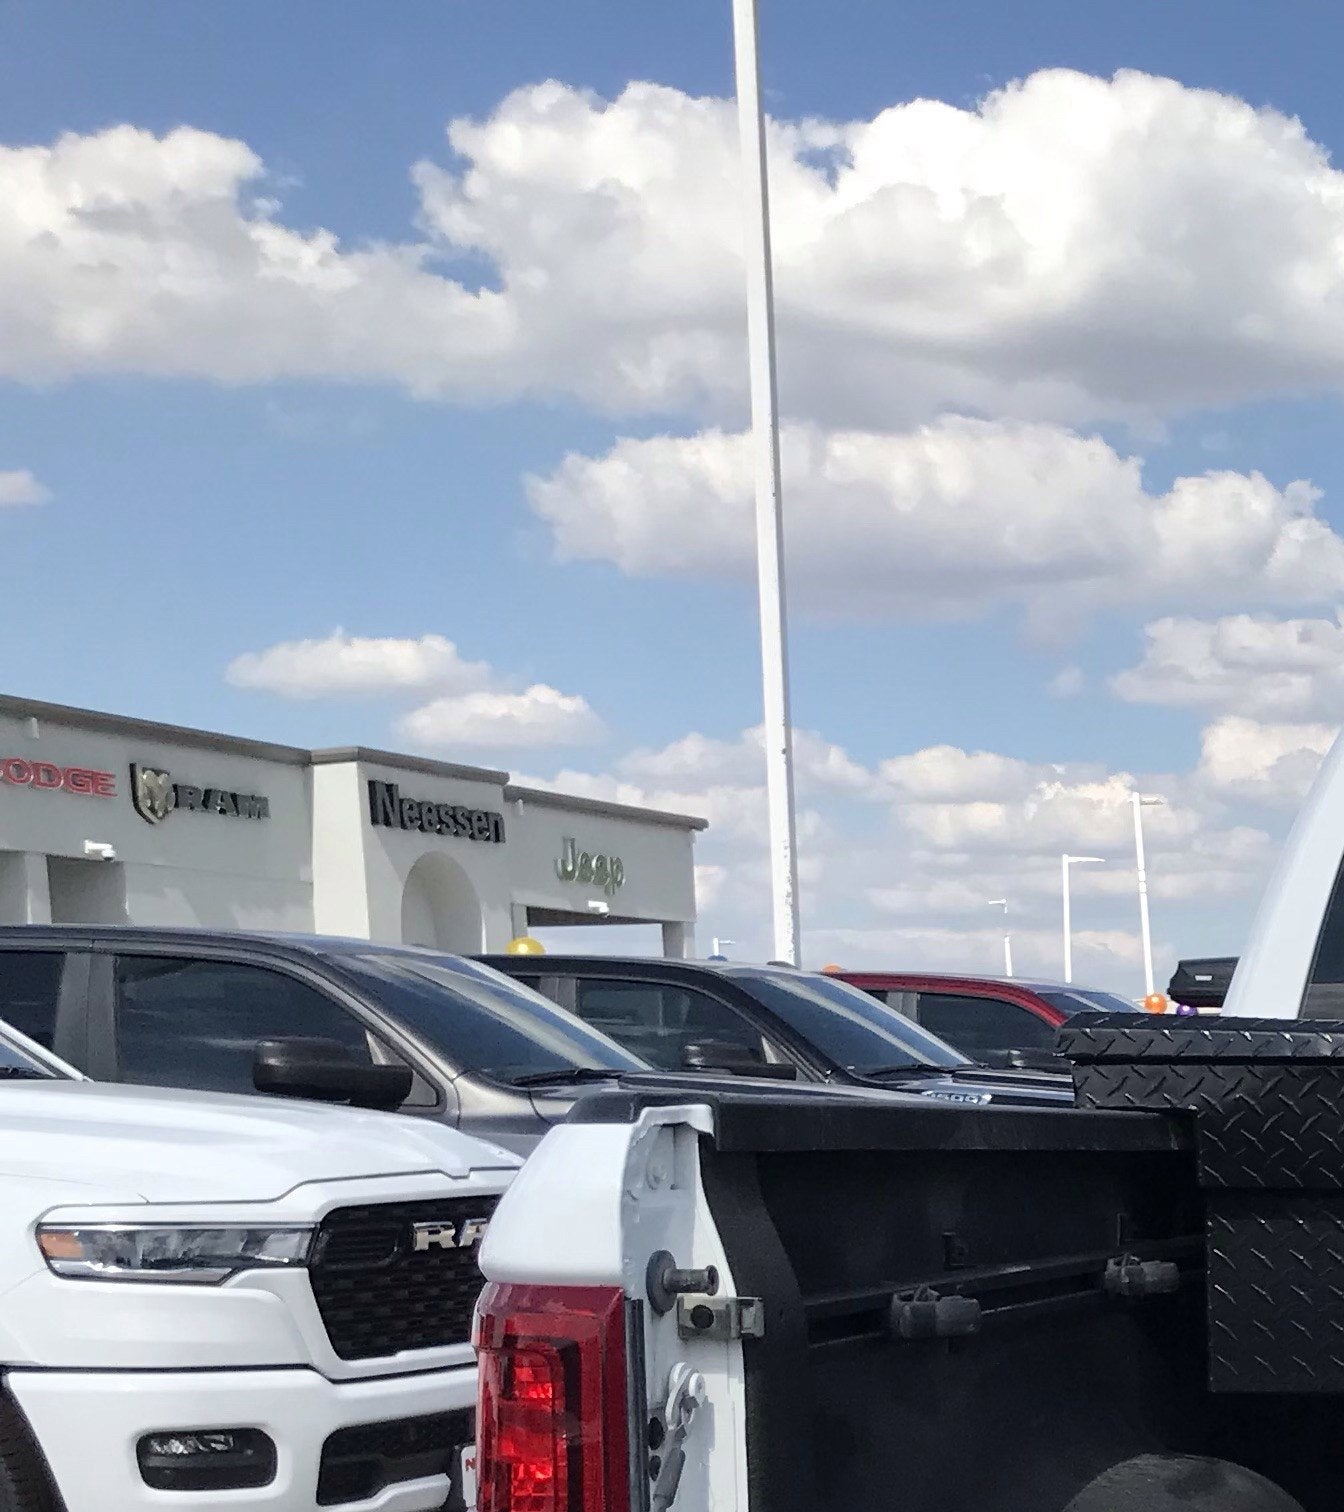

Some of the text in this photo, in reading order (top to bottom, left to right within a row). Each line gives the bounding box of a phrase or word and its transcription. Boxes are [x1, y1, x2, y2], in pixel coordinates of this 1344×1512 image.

[0, 758, 117, 797] ODGE
[173, 784, 270, 819] RAM
[368, 780, 505, 843] Neessen
[554, 836, 626, 895] Jeep
[413, 1218, 489, 1251] RA
